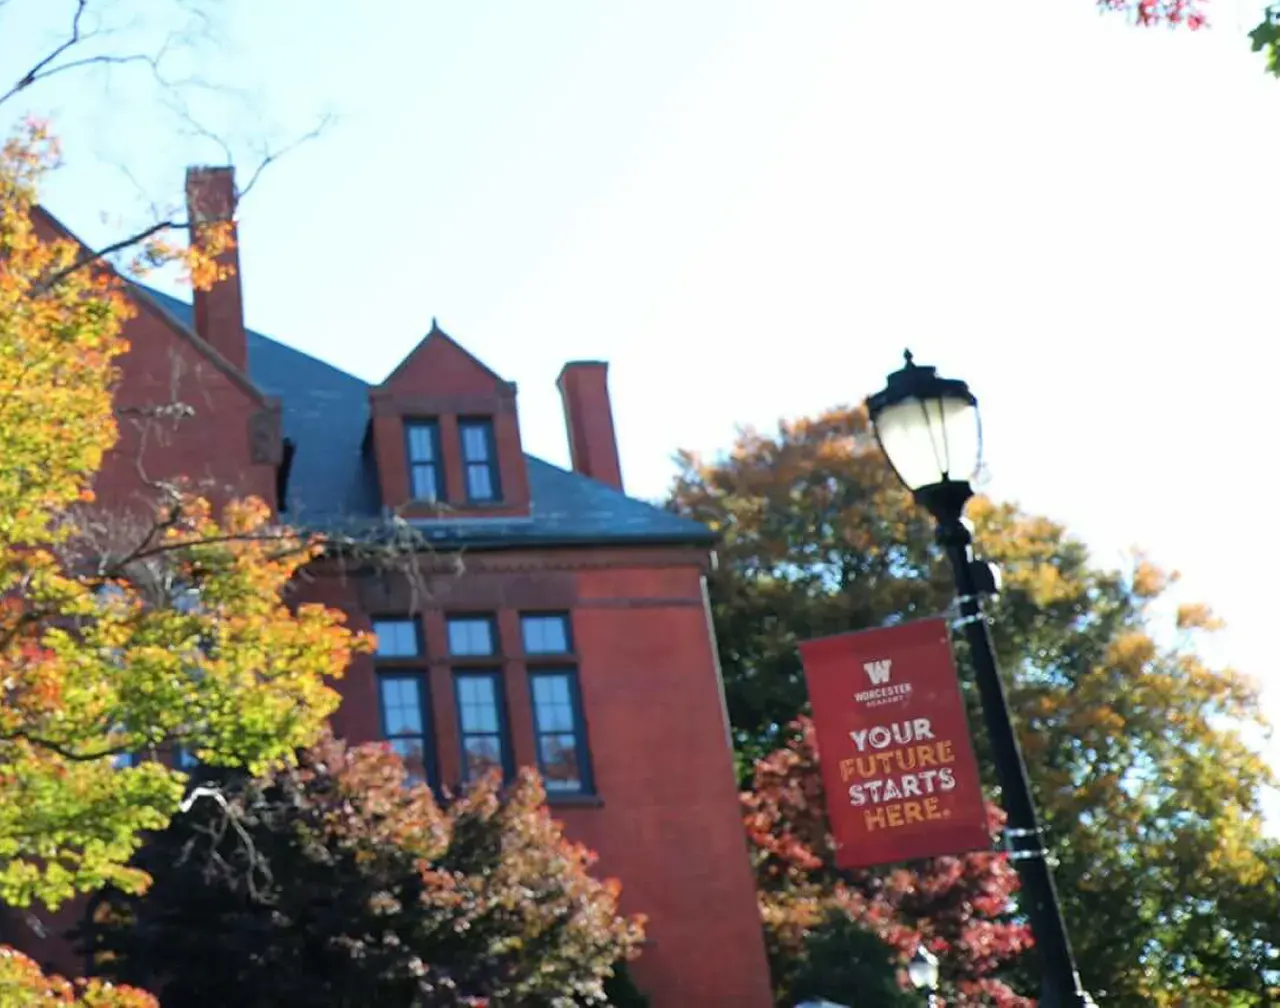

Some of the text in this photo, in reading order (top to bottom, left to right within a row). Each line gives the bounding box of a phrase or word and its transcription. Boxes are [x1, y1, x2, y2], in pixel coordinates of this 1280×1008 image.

[863, 659, 892, 685] W
[853, 683, 912, 702] WORCESTER
[850, 718, 935, 752] YOUR
[839, 741, 955, 782] FUTURE
[849, 768, 956, 806] STARTS
[865, 798, 950, 831] HERE.
